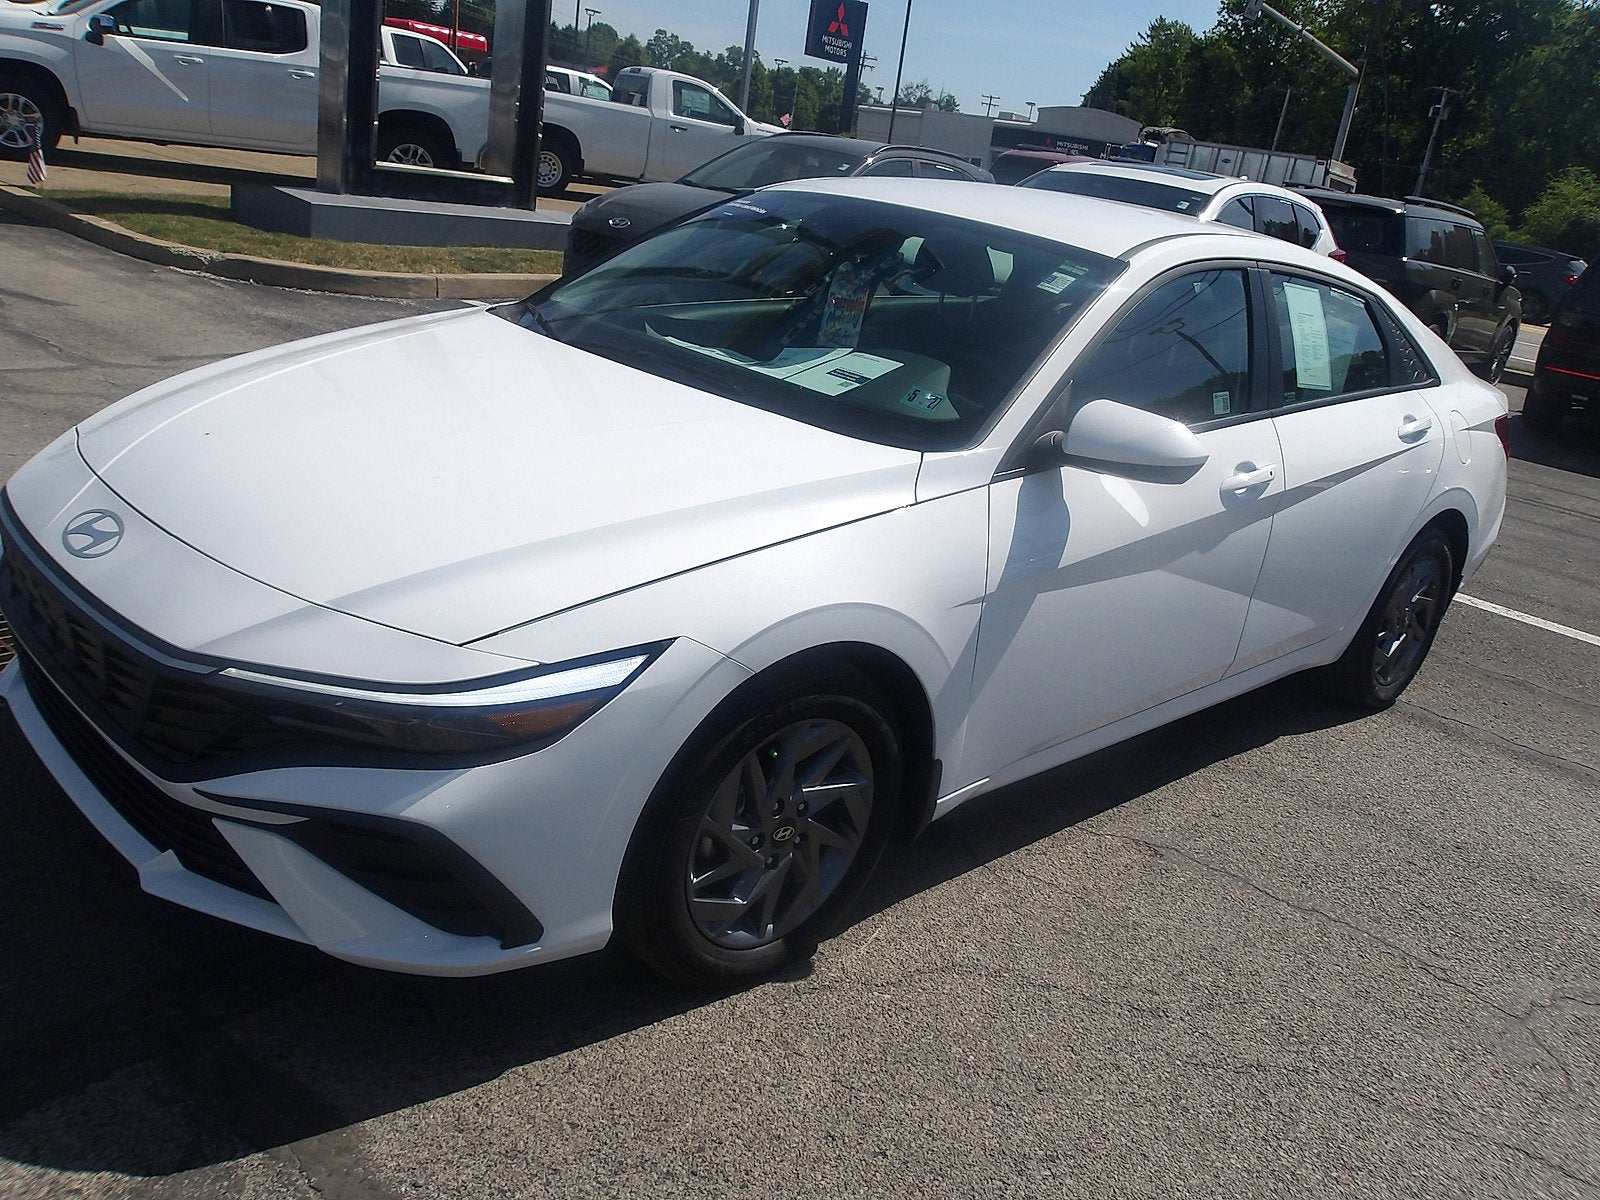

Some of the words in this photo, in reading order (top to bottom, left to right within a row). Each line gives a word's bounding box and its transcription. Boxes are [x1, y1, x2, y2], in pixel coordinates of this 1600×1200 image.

[822, 35, 852, 49] MITSUBISHI
[825, 45, 847, 57] MOTORS
[1056, 141, 1089, 150] MITSUBISHI
